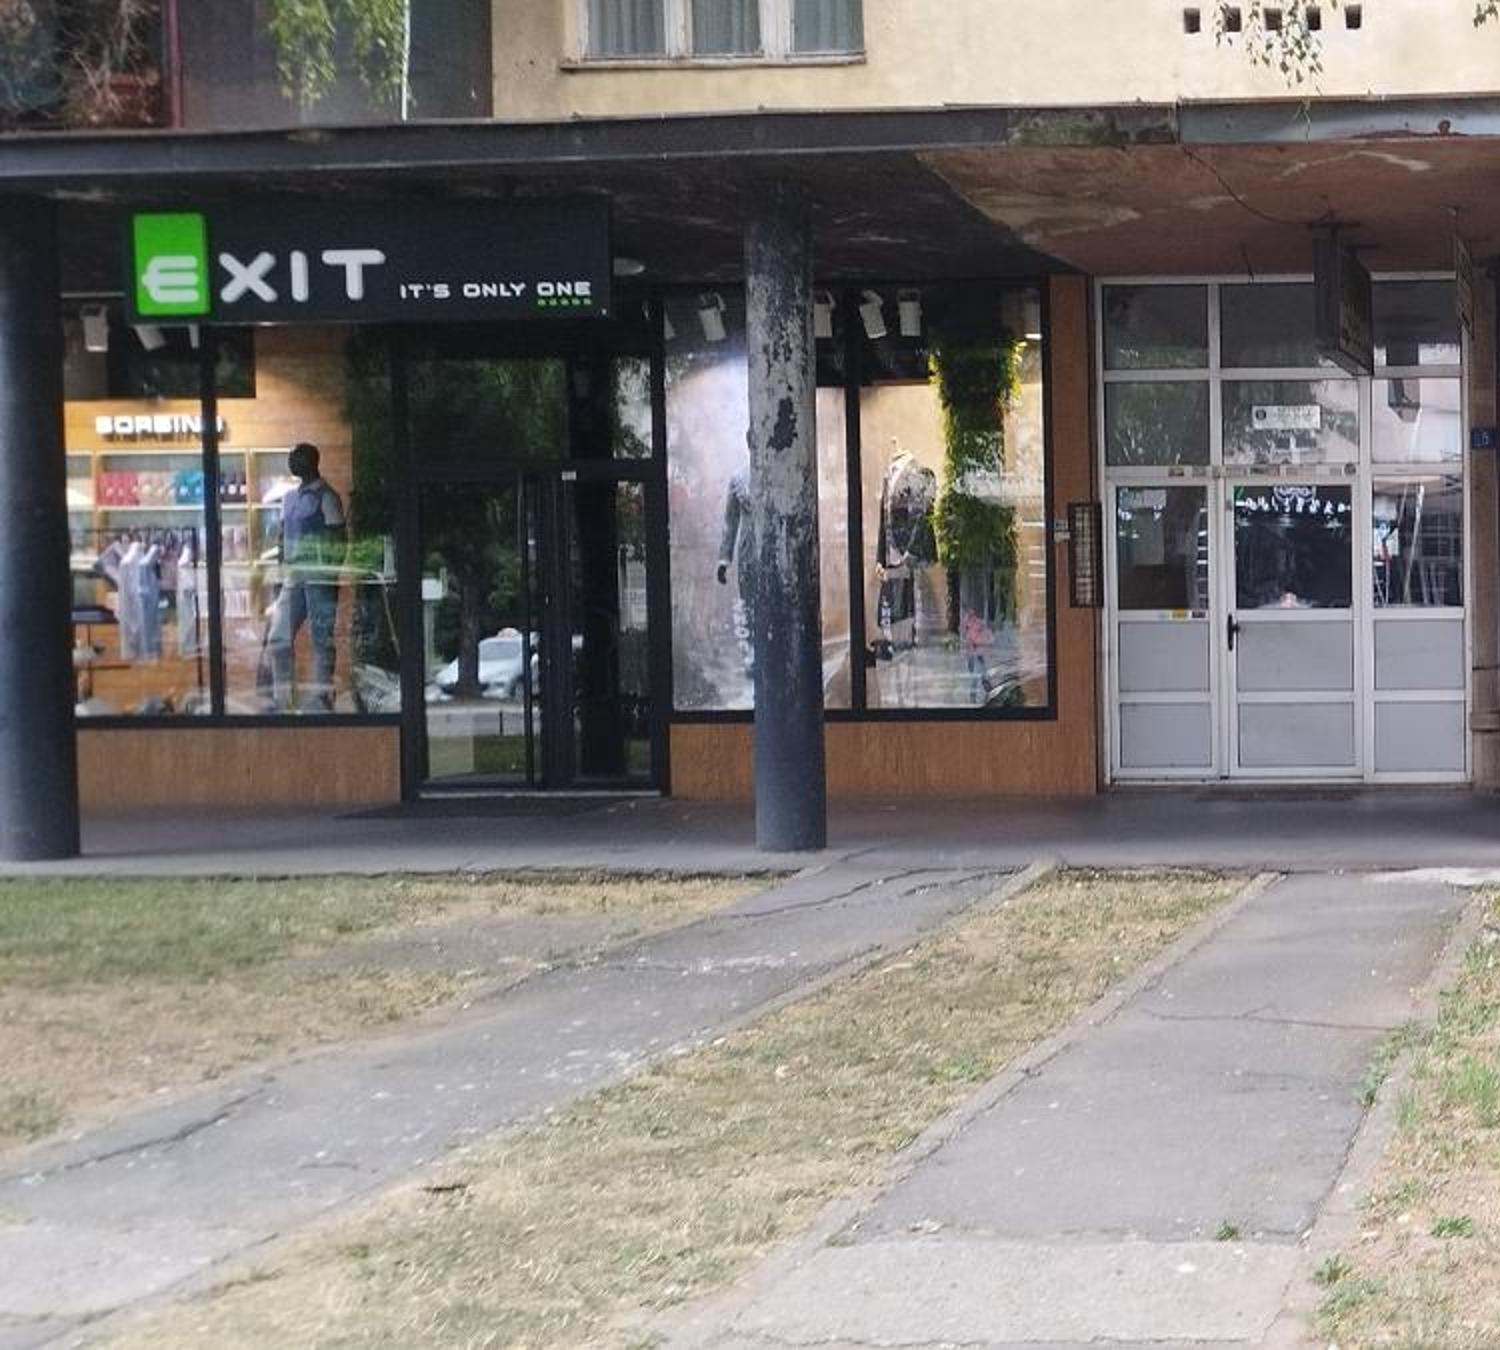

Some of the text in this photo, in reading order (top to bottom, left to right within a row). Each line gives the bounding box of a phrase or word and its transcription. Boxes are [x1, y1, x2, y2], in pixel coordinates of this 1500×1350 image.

[142, 249, 386, 303] EXIT
[400, 281, 591, 299] IT'S ONLY ONE
